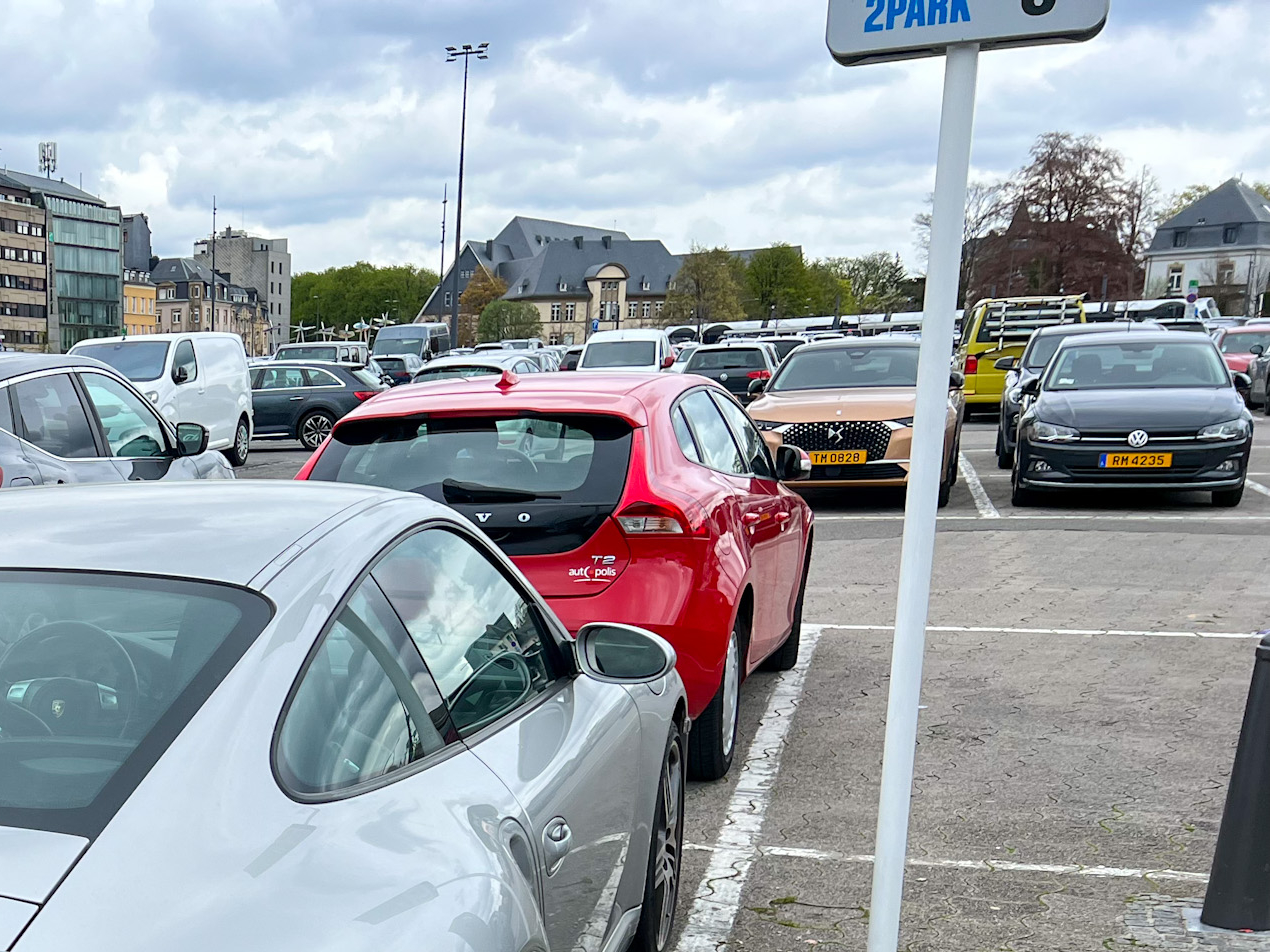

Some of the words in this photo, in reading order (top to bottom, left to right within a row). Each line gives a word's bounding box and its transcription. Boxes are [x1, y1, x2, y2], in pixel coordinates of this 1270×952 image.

[864, 0, 970, 33] 2PARK
[814, 453, 828, 463] TM
[830, 452, 860, 463] 0828
[1112, 456, 1129, 466] RM
[1131, 455, 1165, 466] 4235
[591, 555, 616, 565] T2
